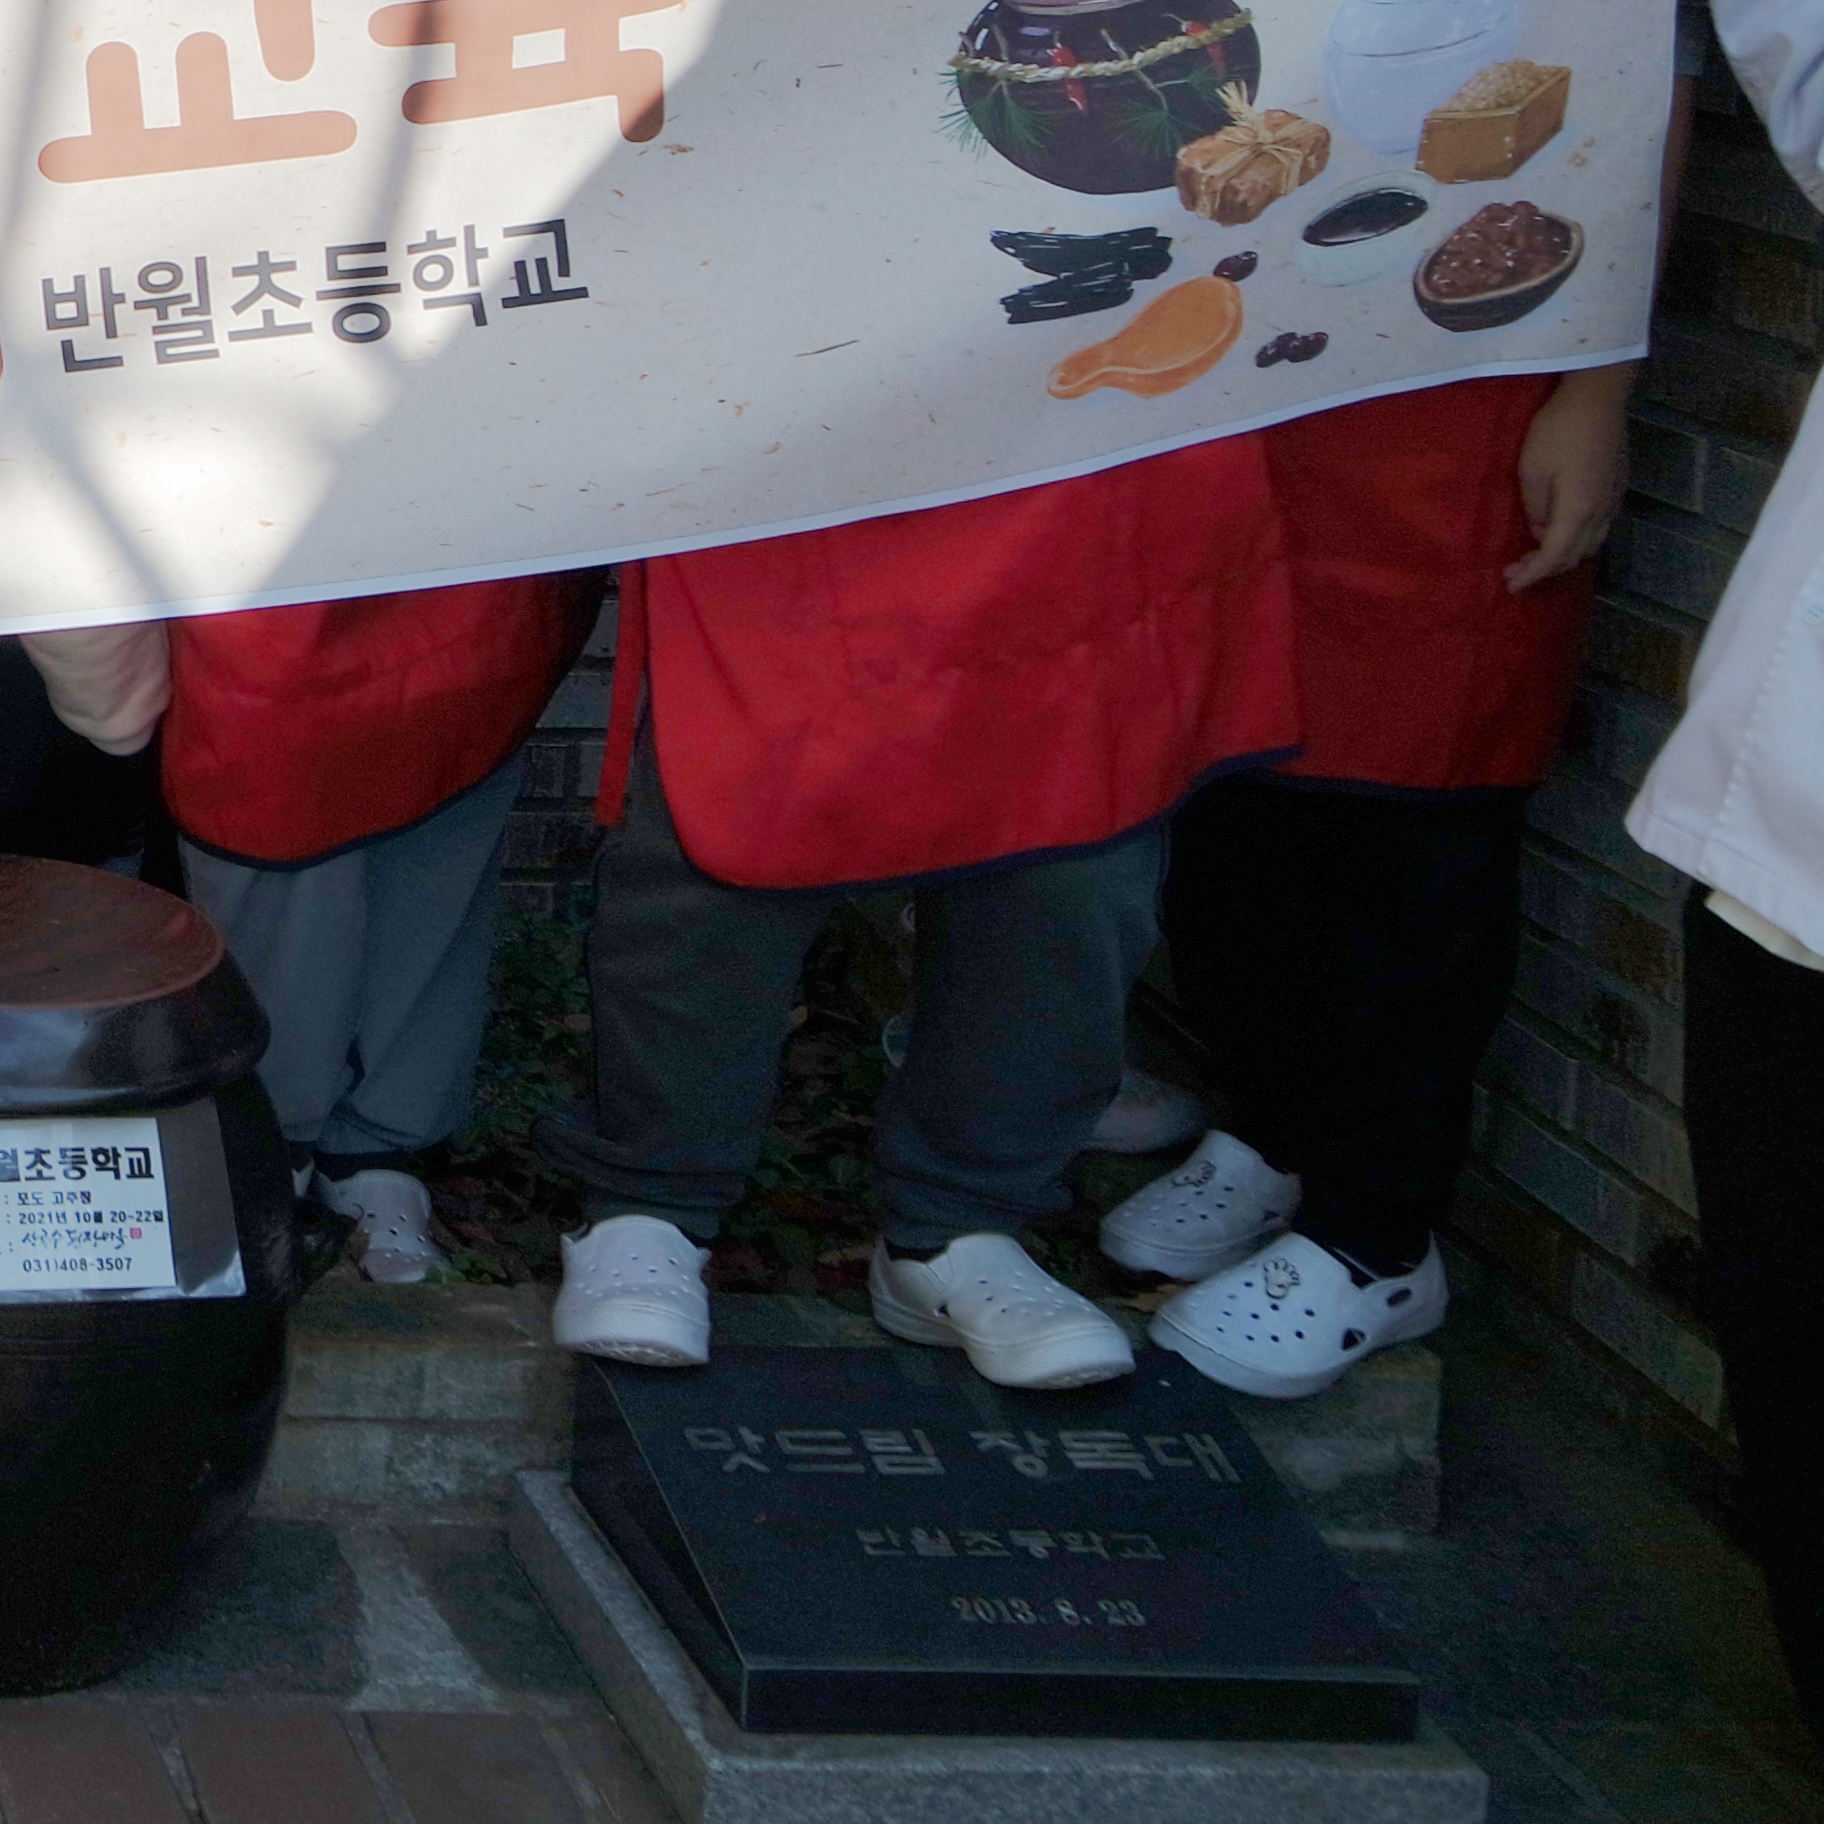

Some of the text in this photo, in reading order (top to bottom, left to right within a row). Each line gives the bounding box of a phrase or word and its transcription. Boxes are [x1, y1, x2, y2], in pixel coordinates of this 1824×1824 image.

[41, 216, 591, 375] 반월초등학교
[18, 1211, 67, 1224] 2021년
[22, 1257, 133, 1273] 031)408-3507
[683, 1425, 1244, 1484] 맛드림 장독대
[854, 1527, 1167, 1562] 반월초등학교
[1097, 1598, 1148, 1627] 23
